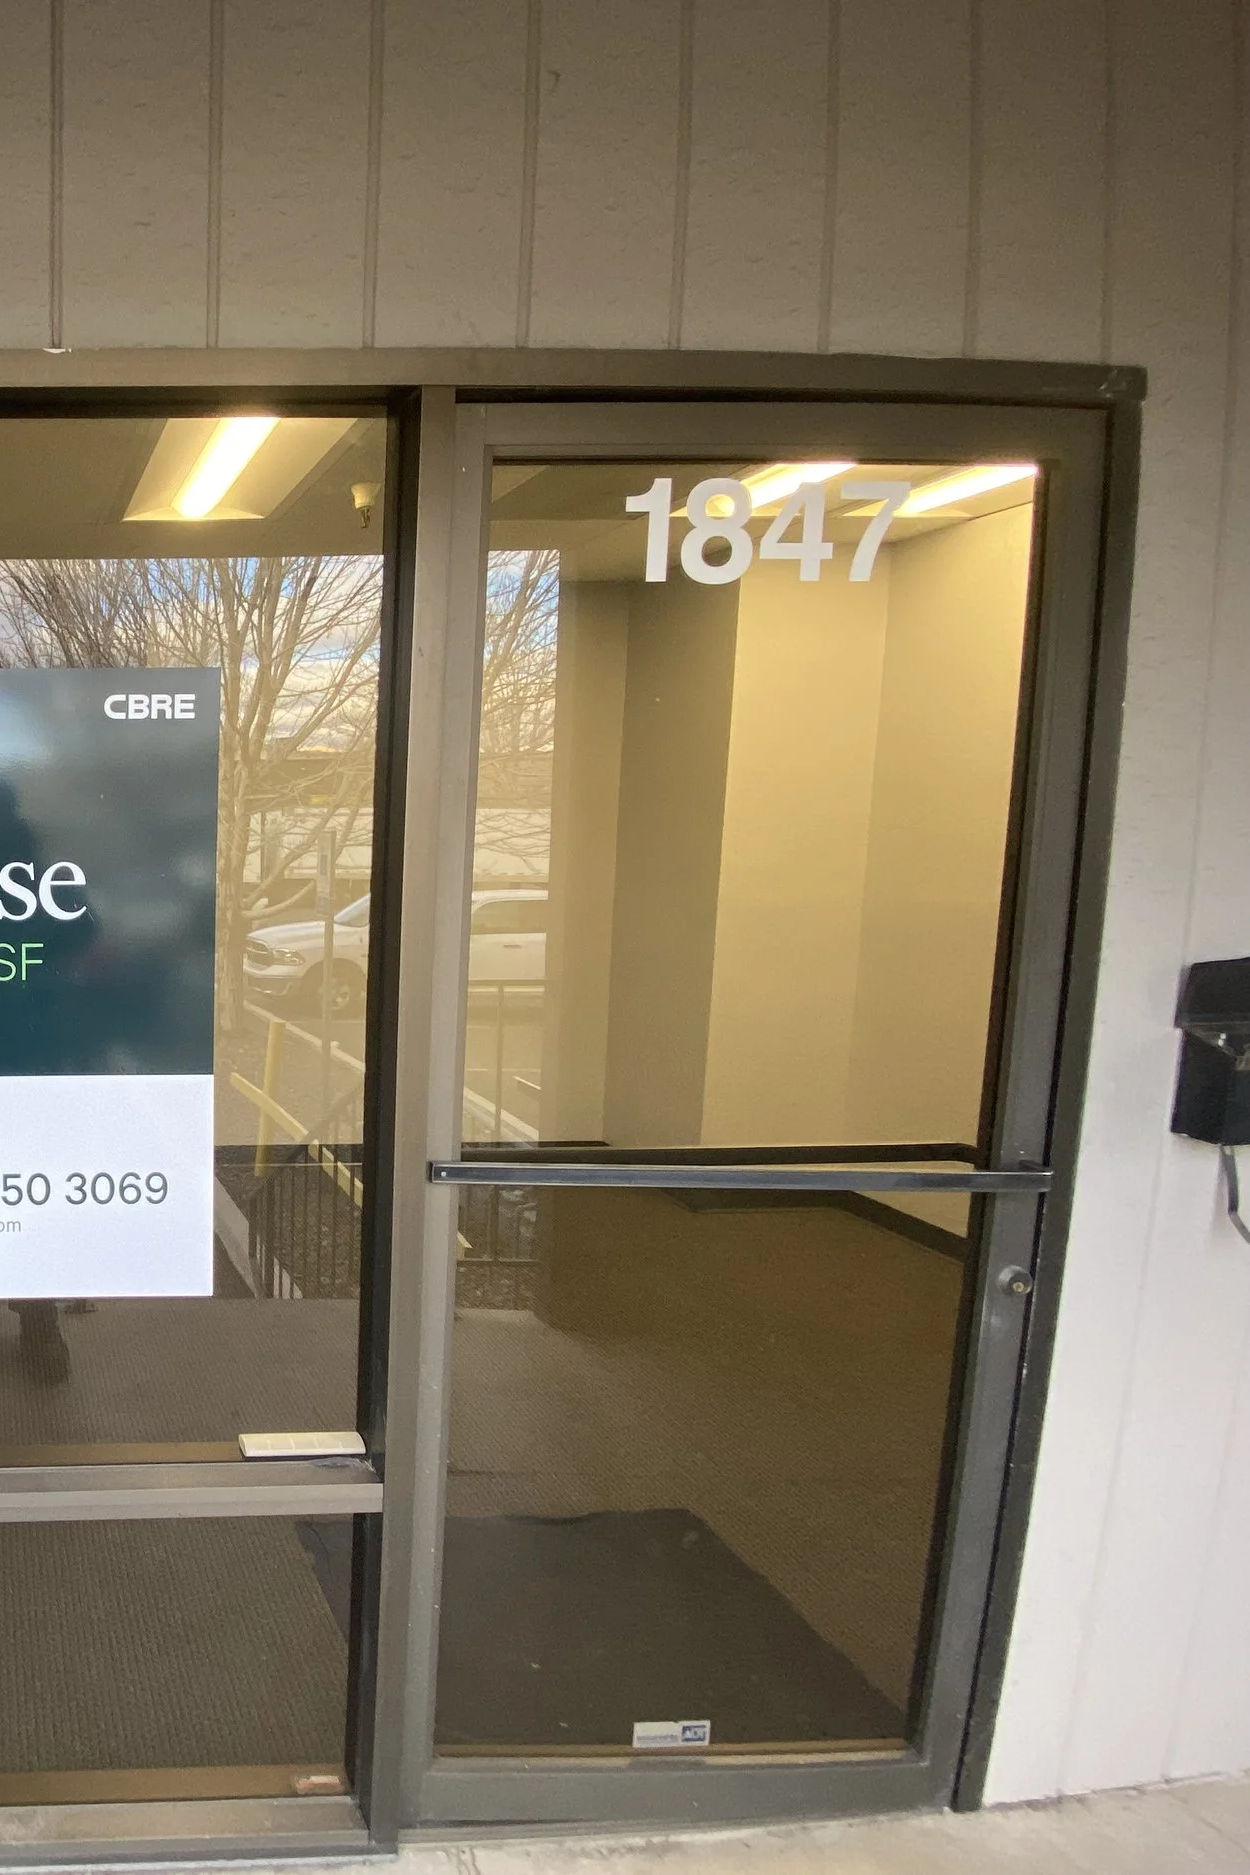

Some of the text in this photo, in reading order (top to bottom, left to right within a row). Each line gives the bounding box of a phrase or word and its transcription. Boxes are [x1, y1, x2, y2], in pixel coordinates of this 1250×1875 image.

[625, 477, 911, 585] 1847
[104, 693, 196, 720] CBRE
[64, 1171, 169, 1205] 3069
